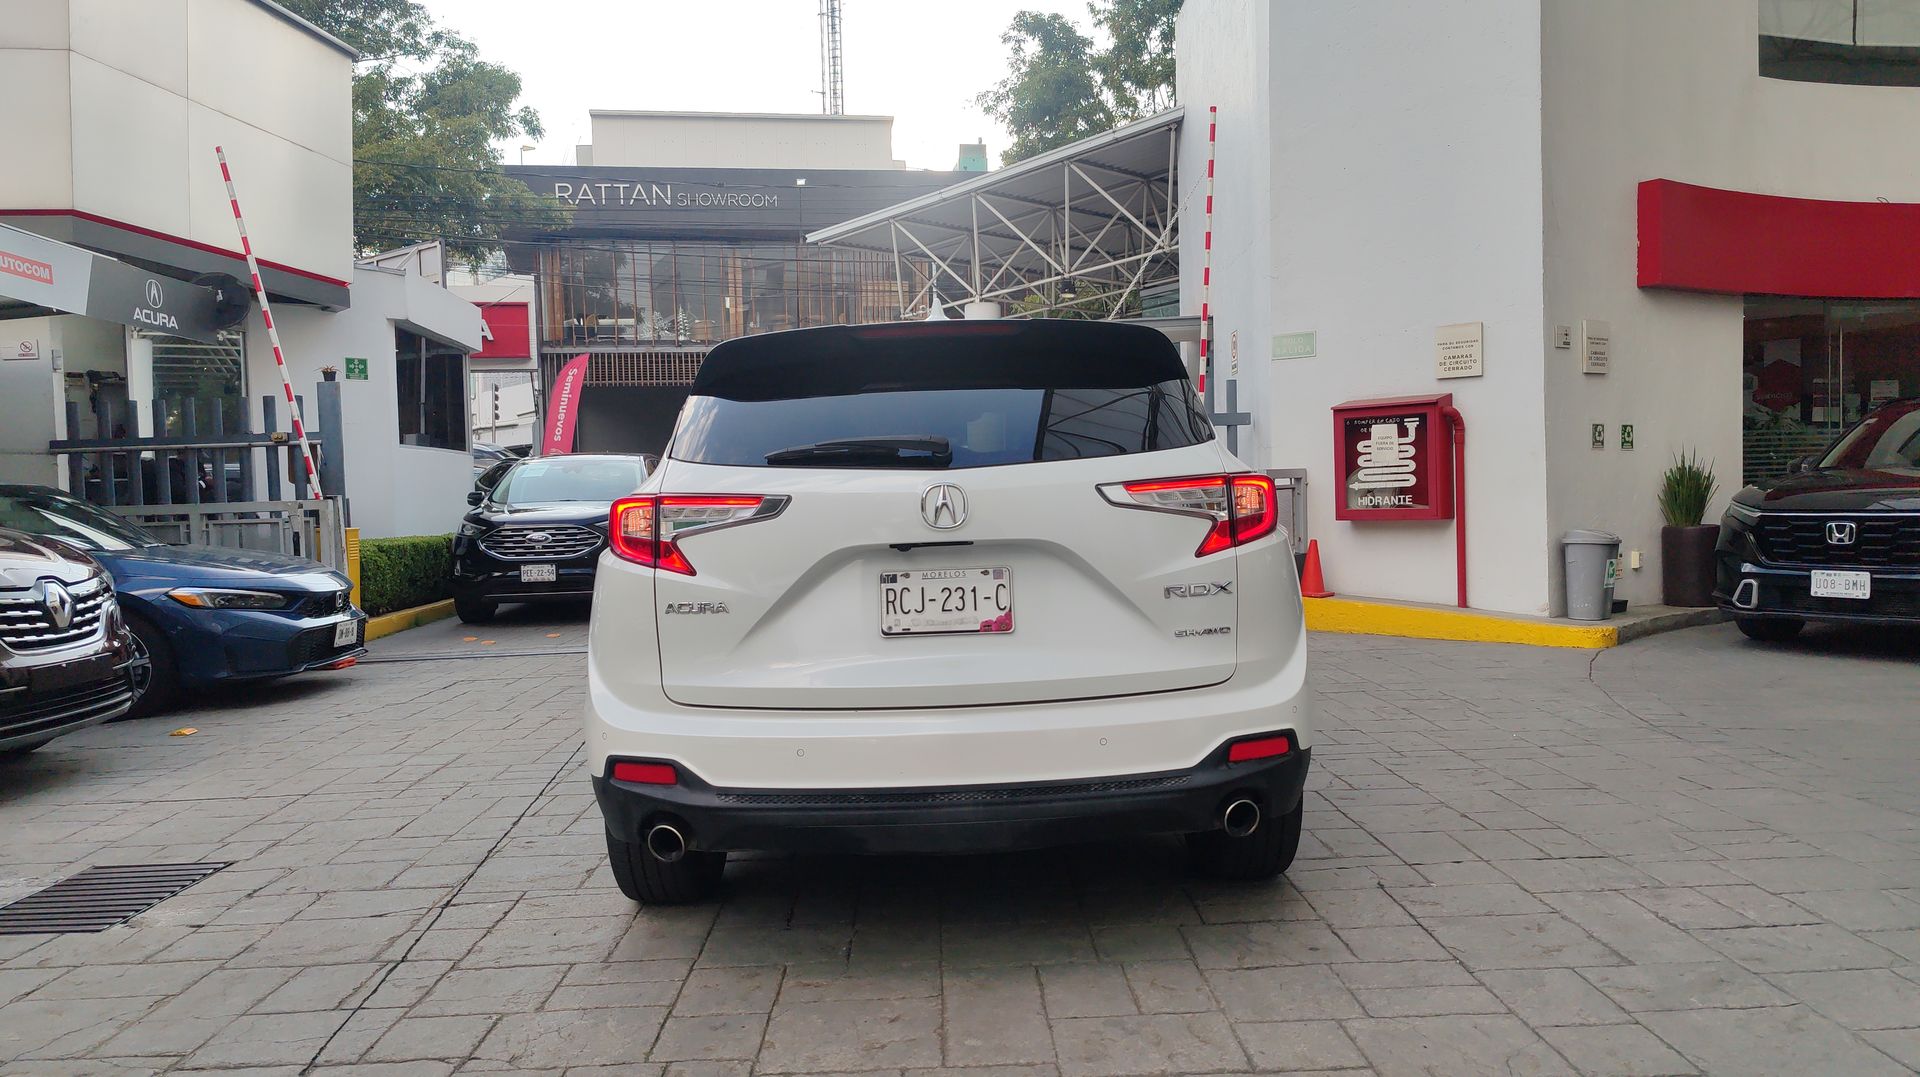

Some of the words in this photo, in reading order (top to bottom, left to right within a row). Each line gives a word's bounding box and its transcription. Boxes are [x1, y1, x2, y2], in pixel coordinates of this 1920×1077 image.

[555, 183, 671, 206] RATTAN
[677, 193, 778, 207] SHOWROOM
[0, 255, 50, 280] UTOCOM
[133, 307, 179, 330] ACURA
[553, 367, 578, 442] Seminuevos
[1358, 494, 1413, 506] HIDRANTE
[921, 570, 968, 579] MORELOS
[885, 583, 1008, 615] RCJ-231-C
[1164, 581, 1233, 600] RDX
[664, 601, 730, 615] ACURA
